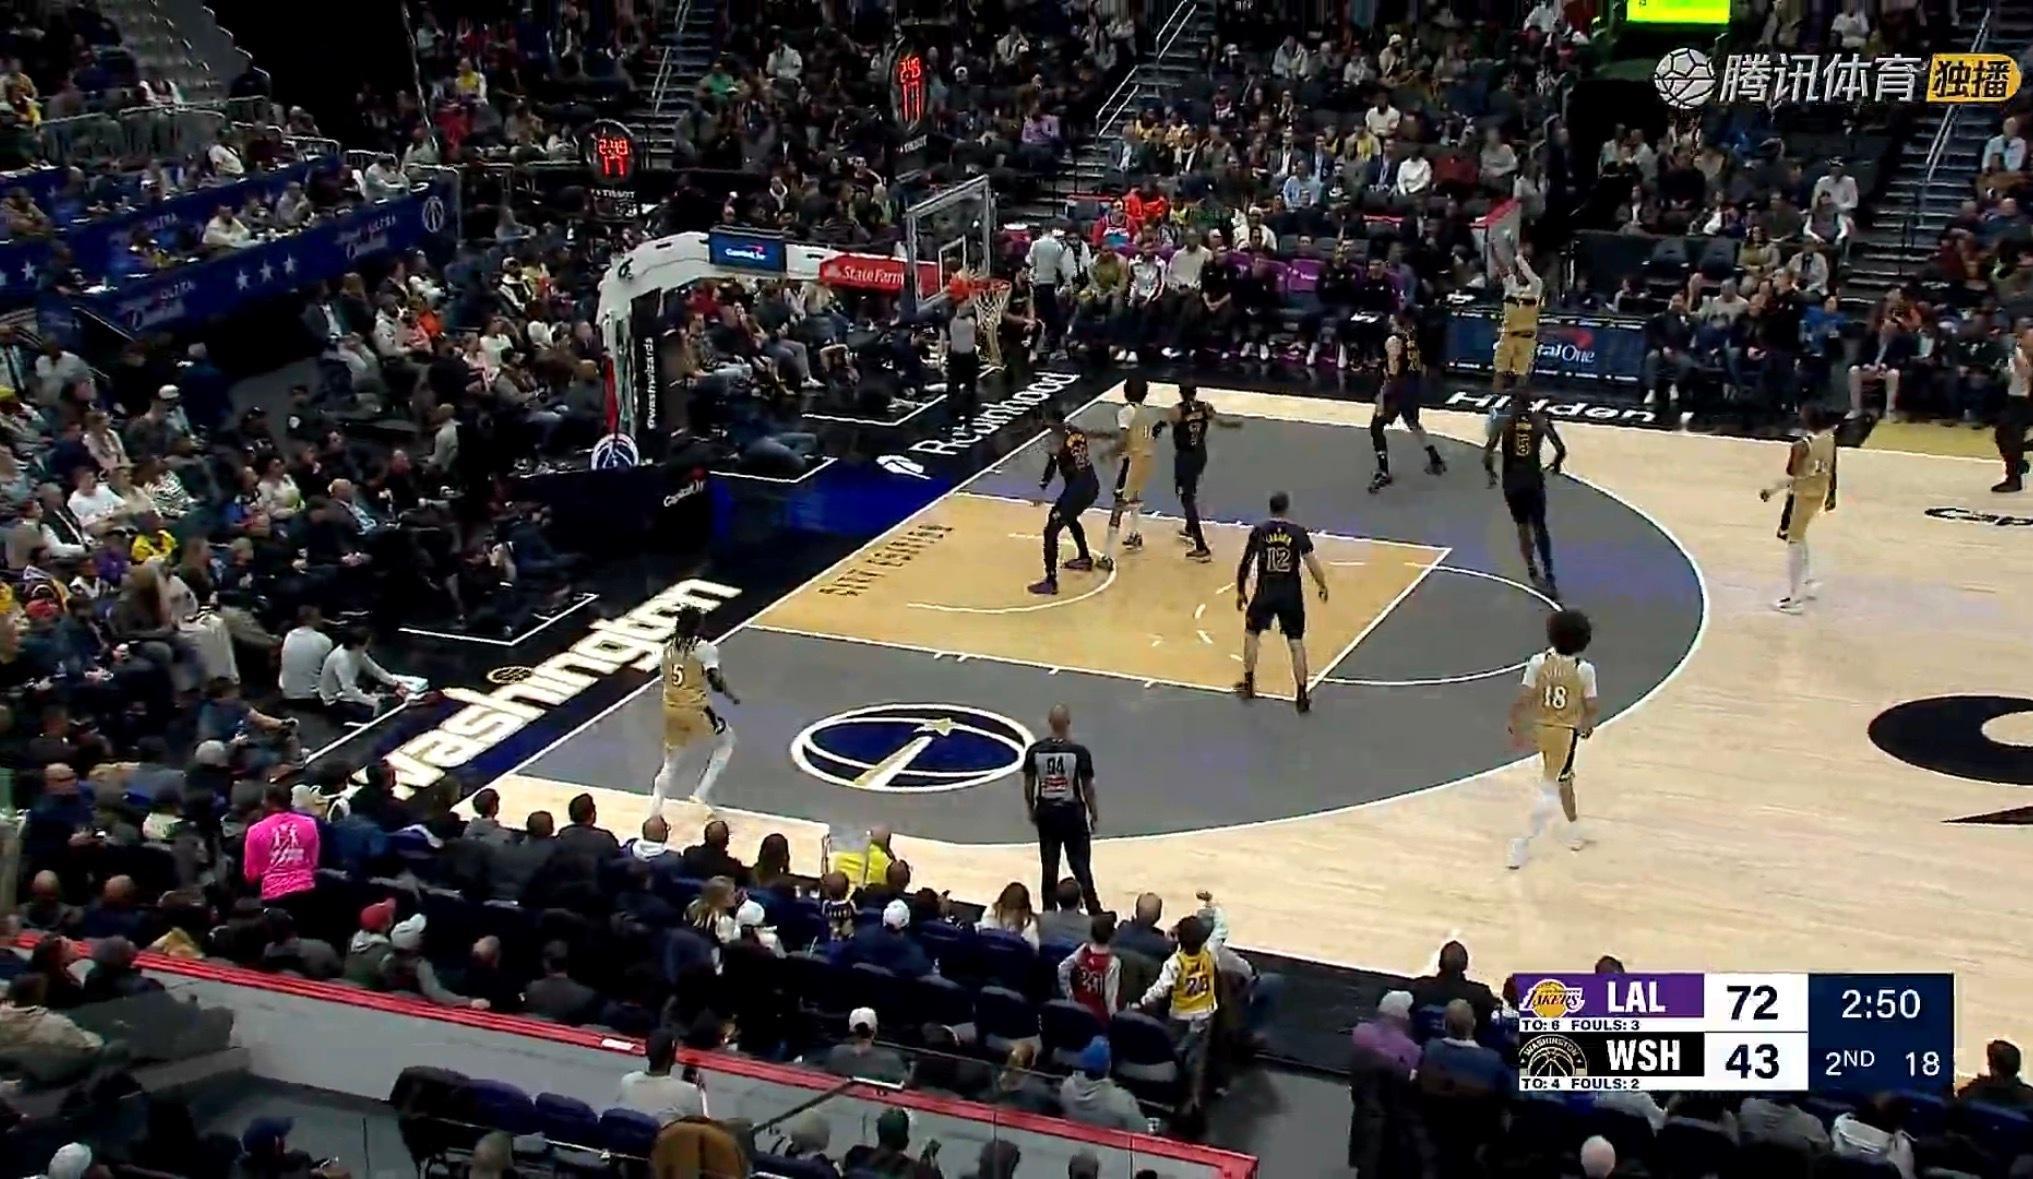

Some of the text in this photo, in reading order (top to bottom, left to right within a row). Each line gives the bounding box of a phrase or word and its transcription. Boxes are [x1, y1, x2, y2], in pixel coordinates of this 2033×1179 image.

[1267, 546, 1291, 572] 12
[671, 663, 685, 687] 5
[1543, 684, 1567, 710] 18
